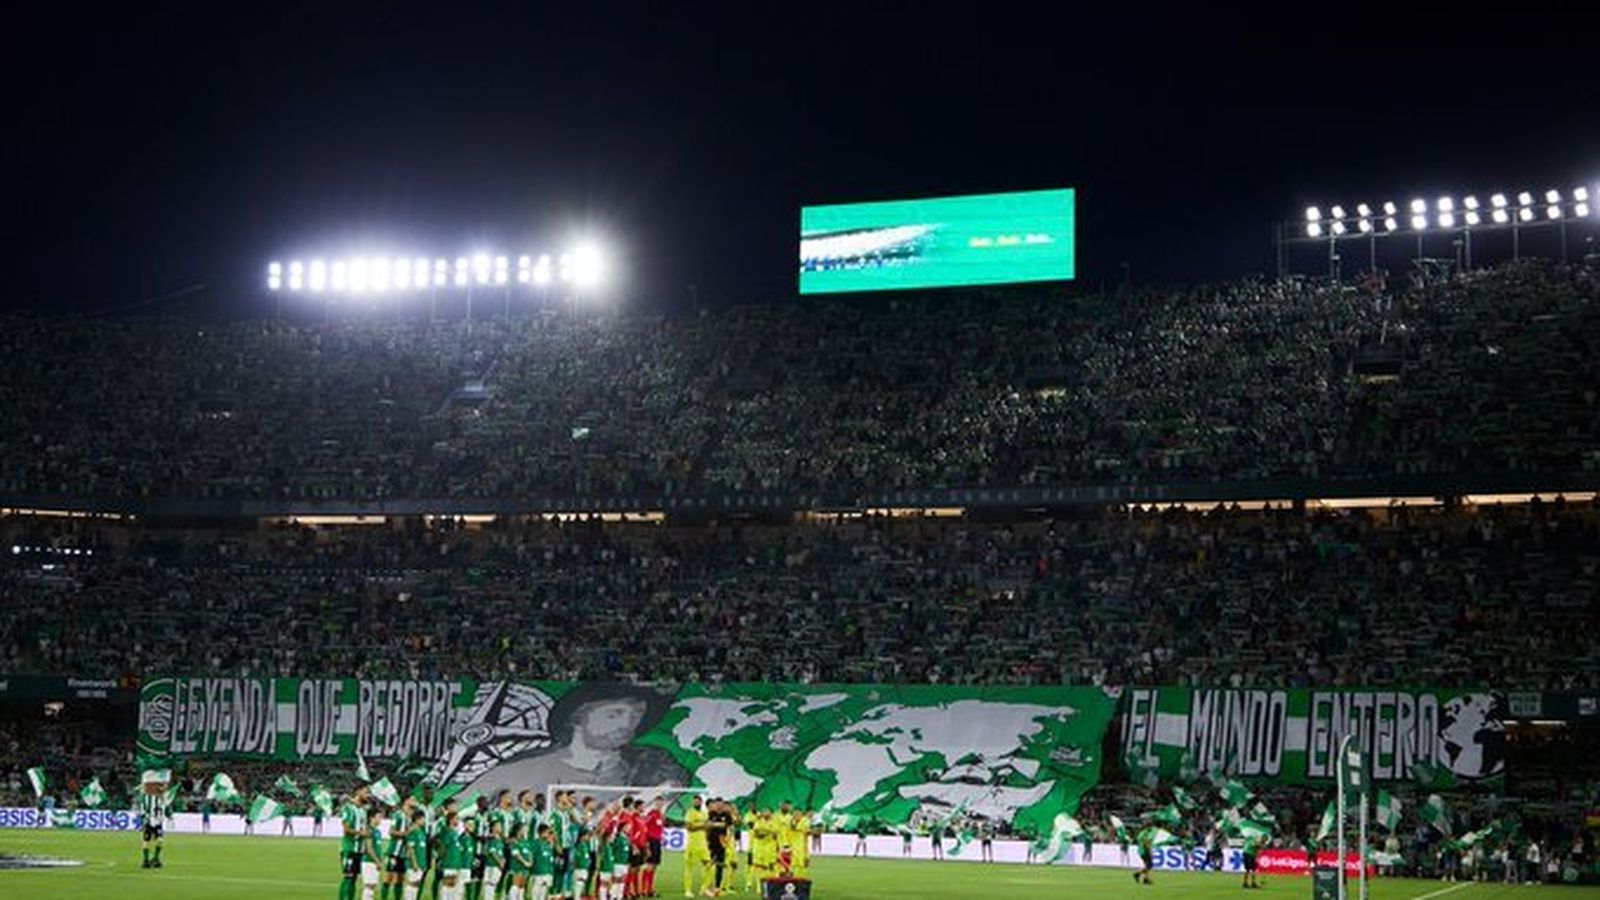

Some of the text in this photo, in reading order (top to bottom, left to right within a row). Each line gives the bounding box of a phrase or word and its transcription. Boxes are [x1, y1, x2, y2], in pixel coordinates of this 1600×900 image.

[170, 678, 462, 759] LEYENDA QUE RECORRE
[1125, 689, 1439, 779] EL MUNDO ENTERO
